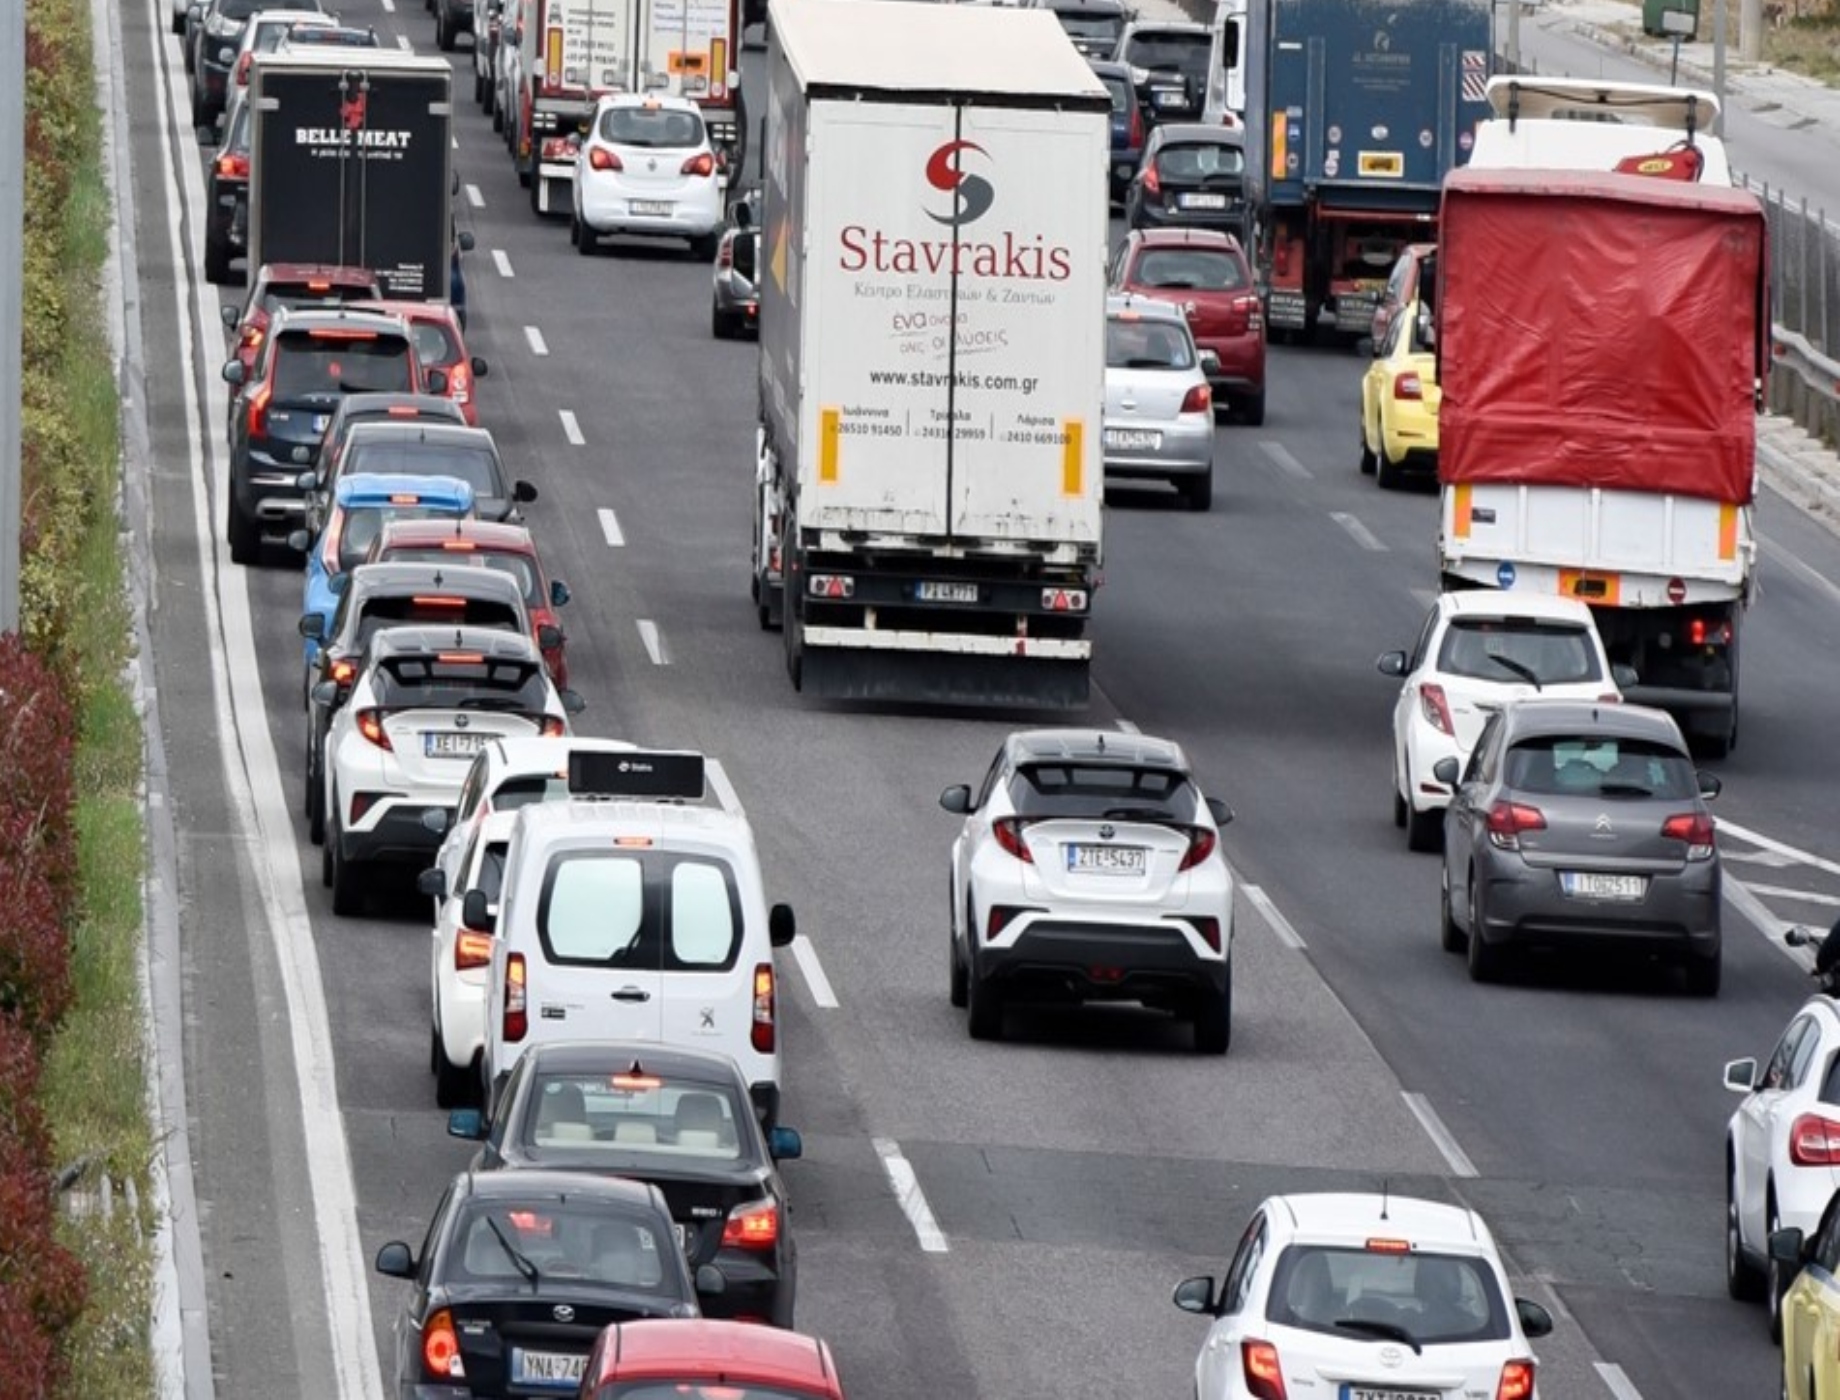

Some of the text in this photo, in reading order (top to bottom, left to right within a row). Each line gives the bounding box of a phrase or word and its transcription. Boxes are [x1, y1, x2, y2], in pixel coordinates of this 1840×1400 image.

[296, 128, 411, 147] BELLE MEAT
[839, 224, 1071, 281] Stavrakis
[526, 1355, 590, 1380] YNA-74
